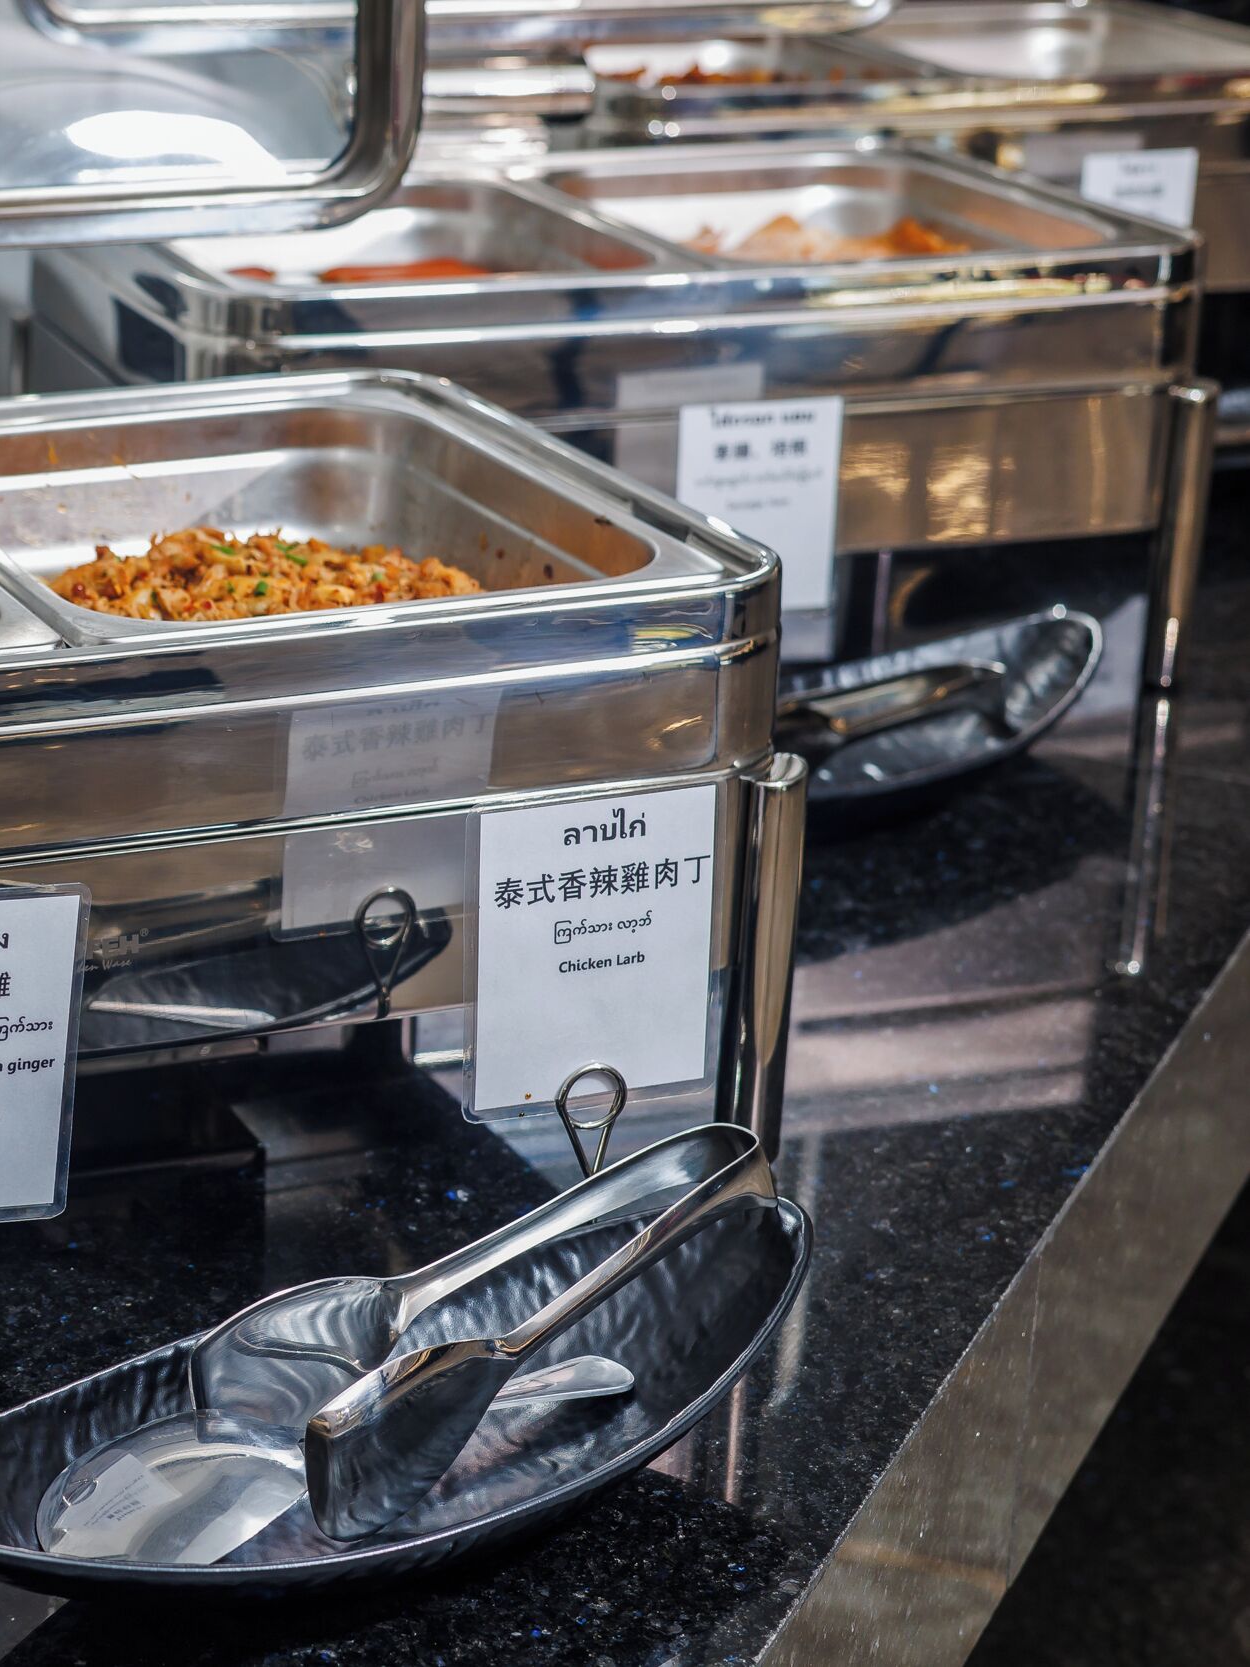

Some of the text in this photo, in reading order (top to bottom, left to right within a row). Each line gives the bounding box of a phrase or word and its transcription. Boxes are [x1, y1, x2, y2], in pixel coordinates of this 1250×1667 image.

[563, 808, 646, 846] ลาบไก่
[494, 854, 711, 909] 泰式香辣雞肉丁
[554, 919, 613, 944] ကြက်သား
[559, 951, 645, 973] Chicken Larb
[7, 1057, 55, 1075] ginger
